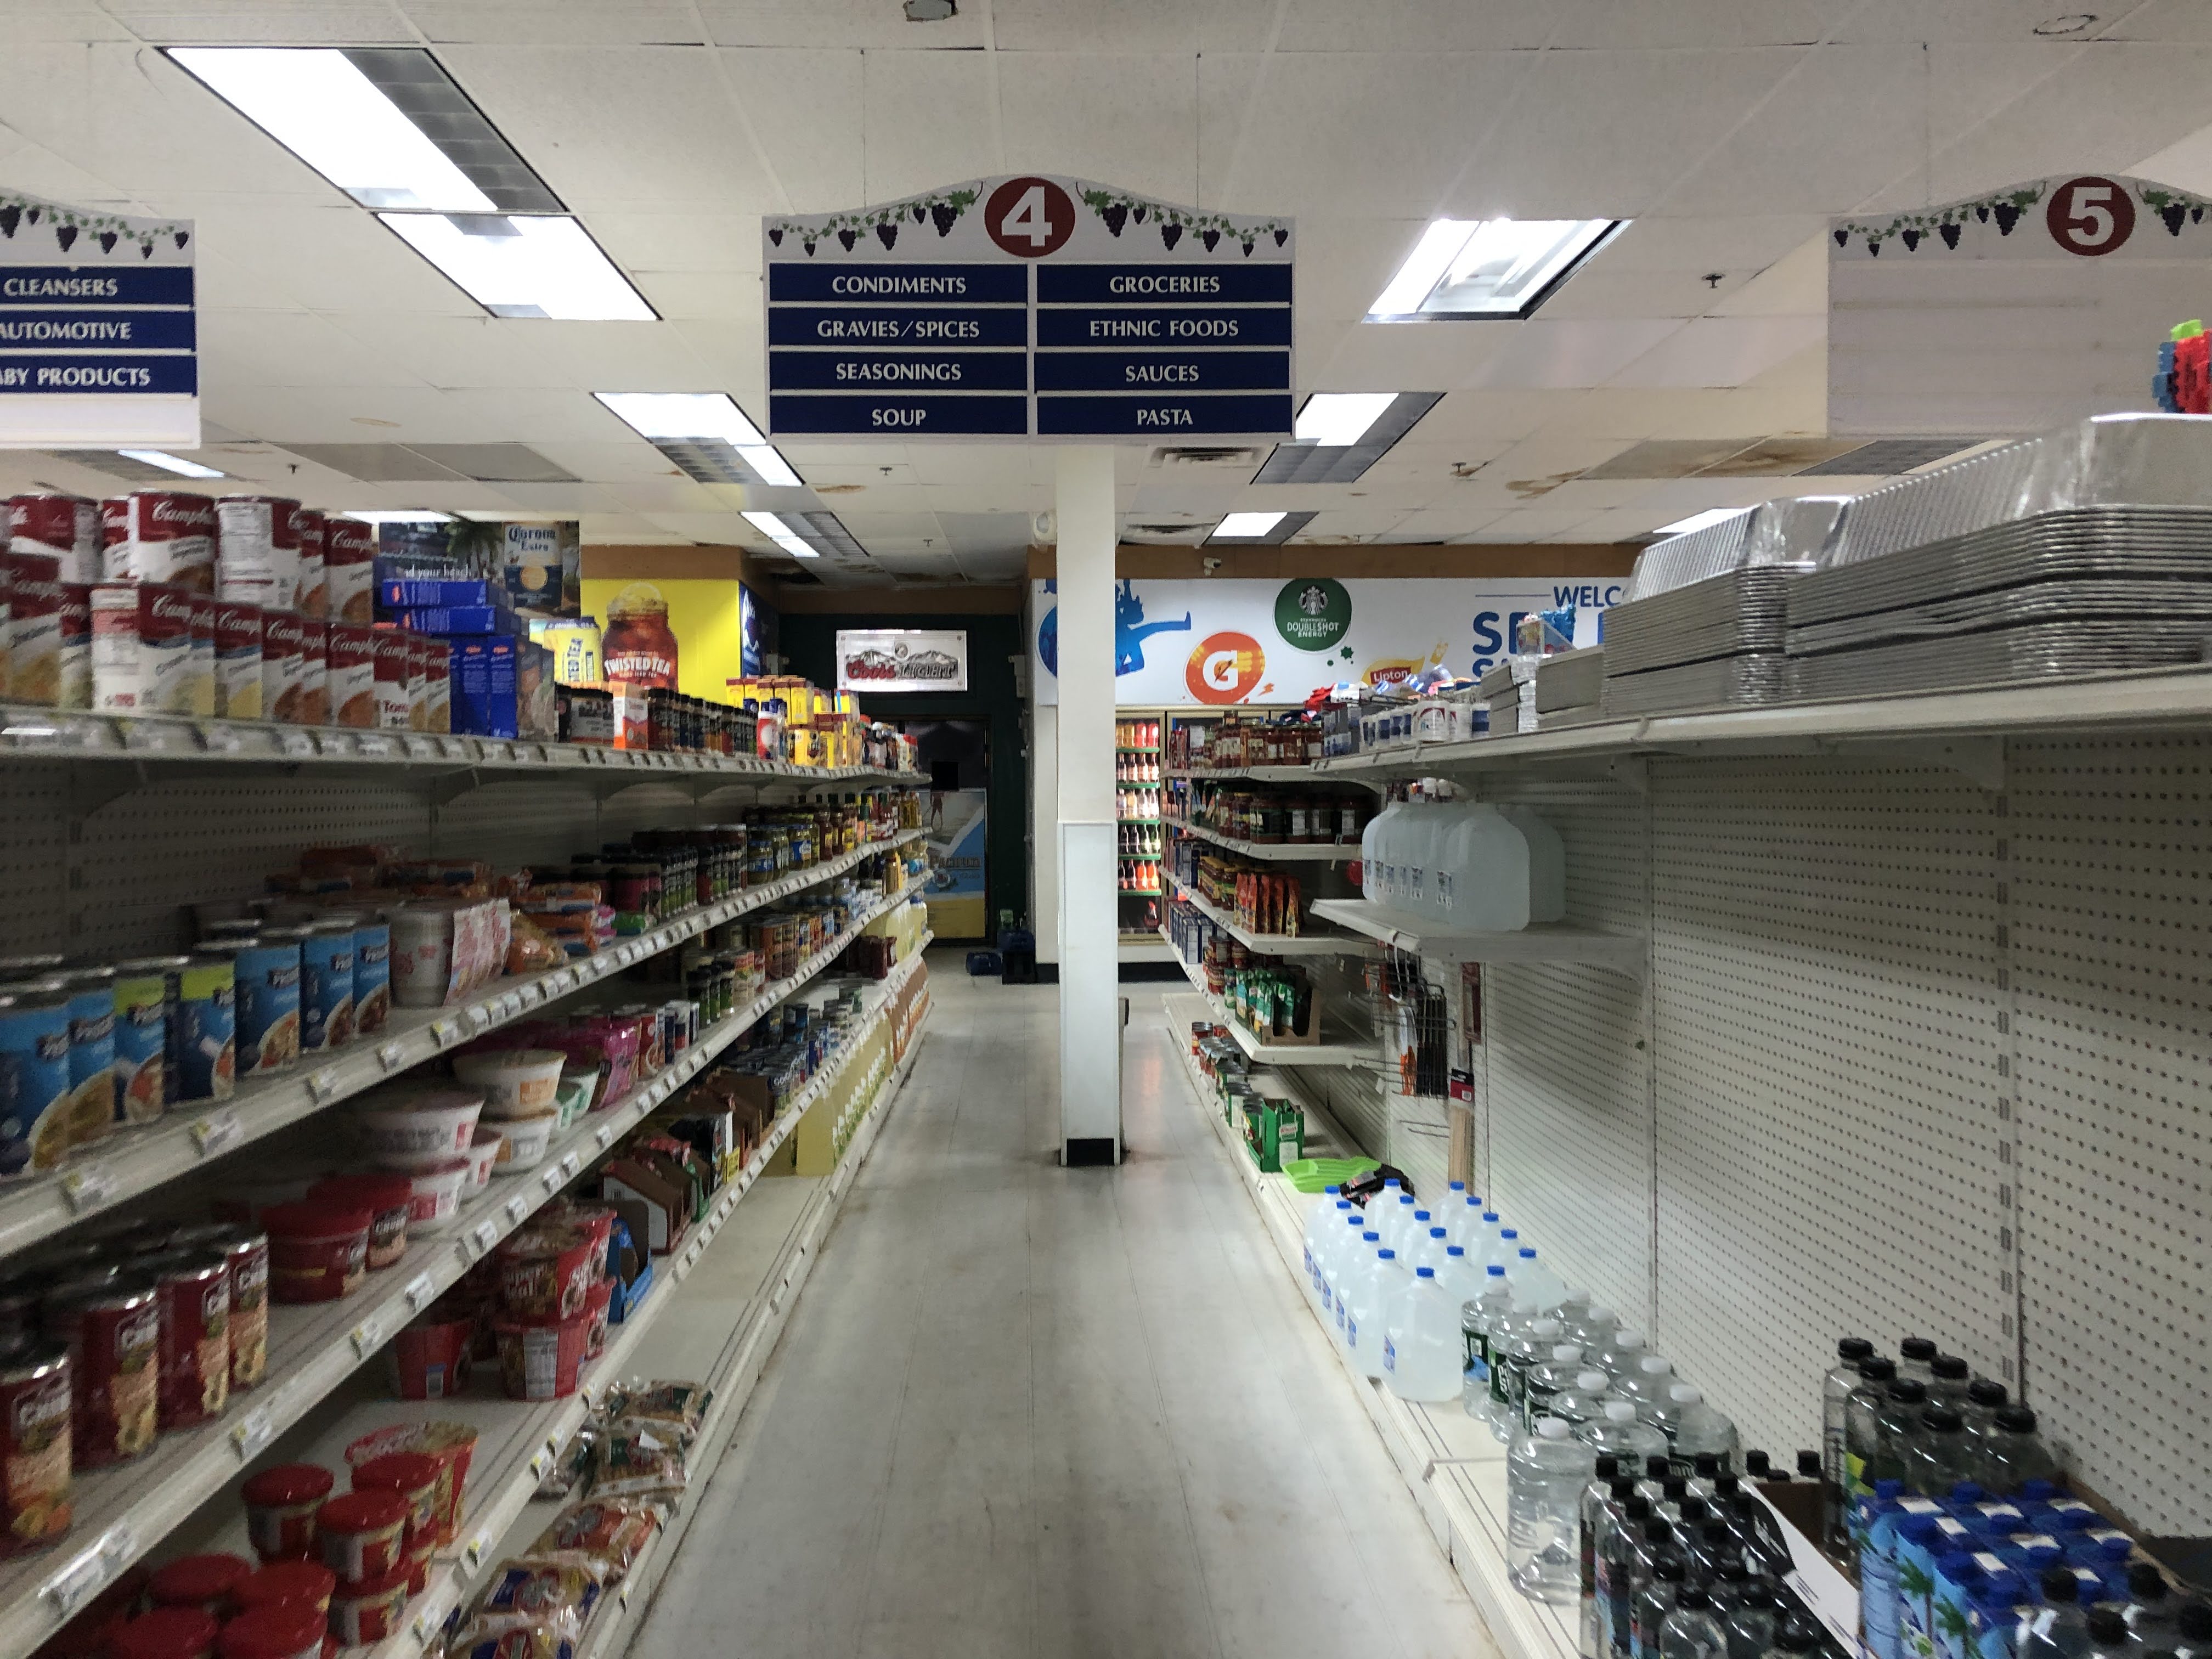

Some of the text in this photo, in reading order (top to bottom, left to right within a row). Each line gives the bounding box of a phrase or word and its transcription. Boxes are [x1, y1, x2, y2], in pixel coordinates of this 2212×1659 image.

[1001, 185, 1052, 247] 4
[2066, 187, 2114, 246] 5
[3, 278, 118, 297] CLEANSERS
[832, 276, 966, 294] CONDIMENTS
[1109, 276, 1220, 294] GROCERIES
[817, 319, 980, 338] GRAVIES/SPICES
[1090, 319, 1239, 336] ETHNIC FOODS
[0, 367, 150, 386] BY PRODUCTS
[836, 363, 962, 381] SEASONINGS
[1125, 365, 1199, 382] SAUCES
[871, 409, 927, 426] SOUP
[1137, 409, 1194, 425] PASTA
[508, 524, 556, 544] Corona
[1553, 585, 1628, 608] WELC
[604, 657, 651, 676] TWISTED
[652, 657, 670, 676] TEA
[847, 658, 956, 680] Coors LIGHT
[1202, 650, 1239, 691] G
[1373, 669, 1408, 682] Lipton
